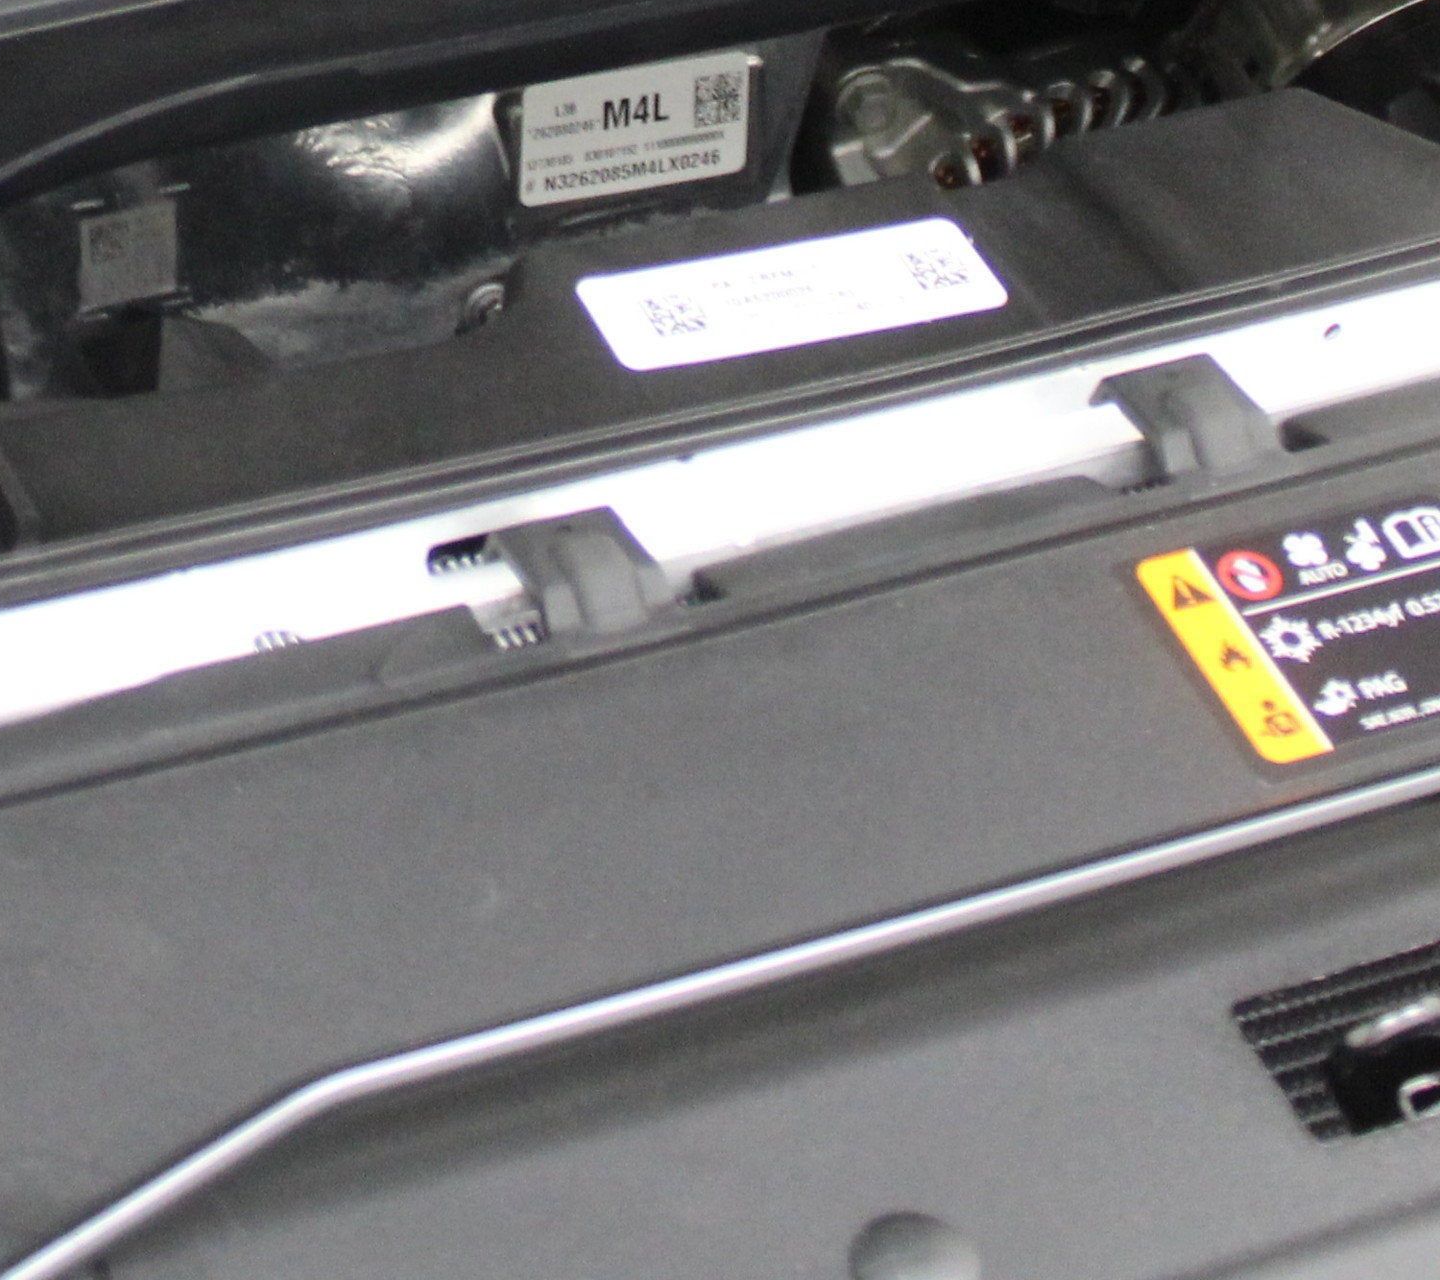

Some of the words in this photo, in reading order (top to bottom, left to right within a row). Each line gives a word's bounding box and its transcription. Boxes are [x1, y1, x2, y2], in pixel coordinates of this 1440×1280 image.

[602, 92, 670, 131] M4L
[1298, 560, 1349, 586] AUTO
[1316, 602, 1406, 640] R-1234yf
[1357, 671, 1409, 700] PAG
